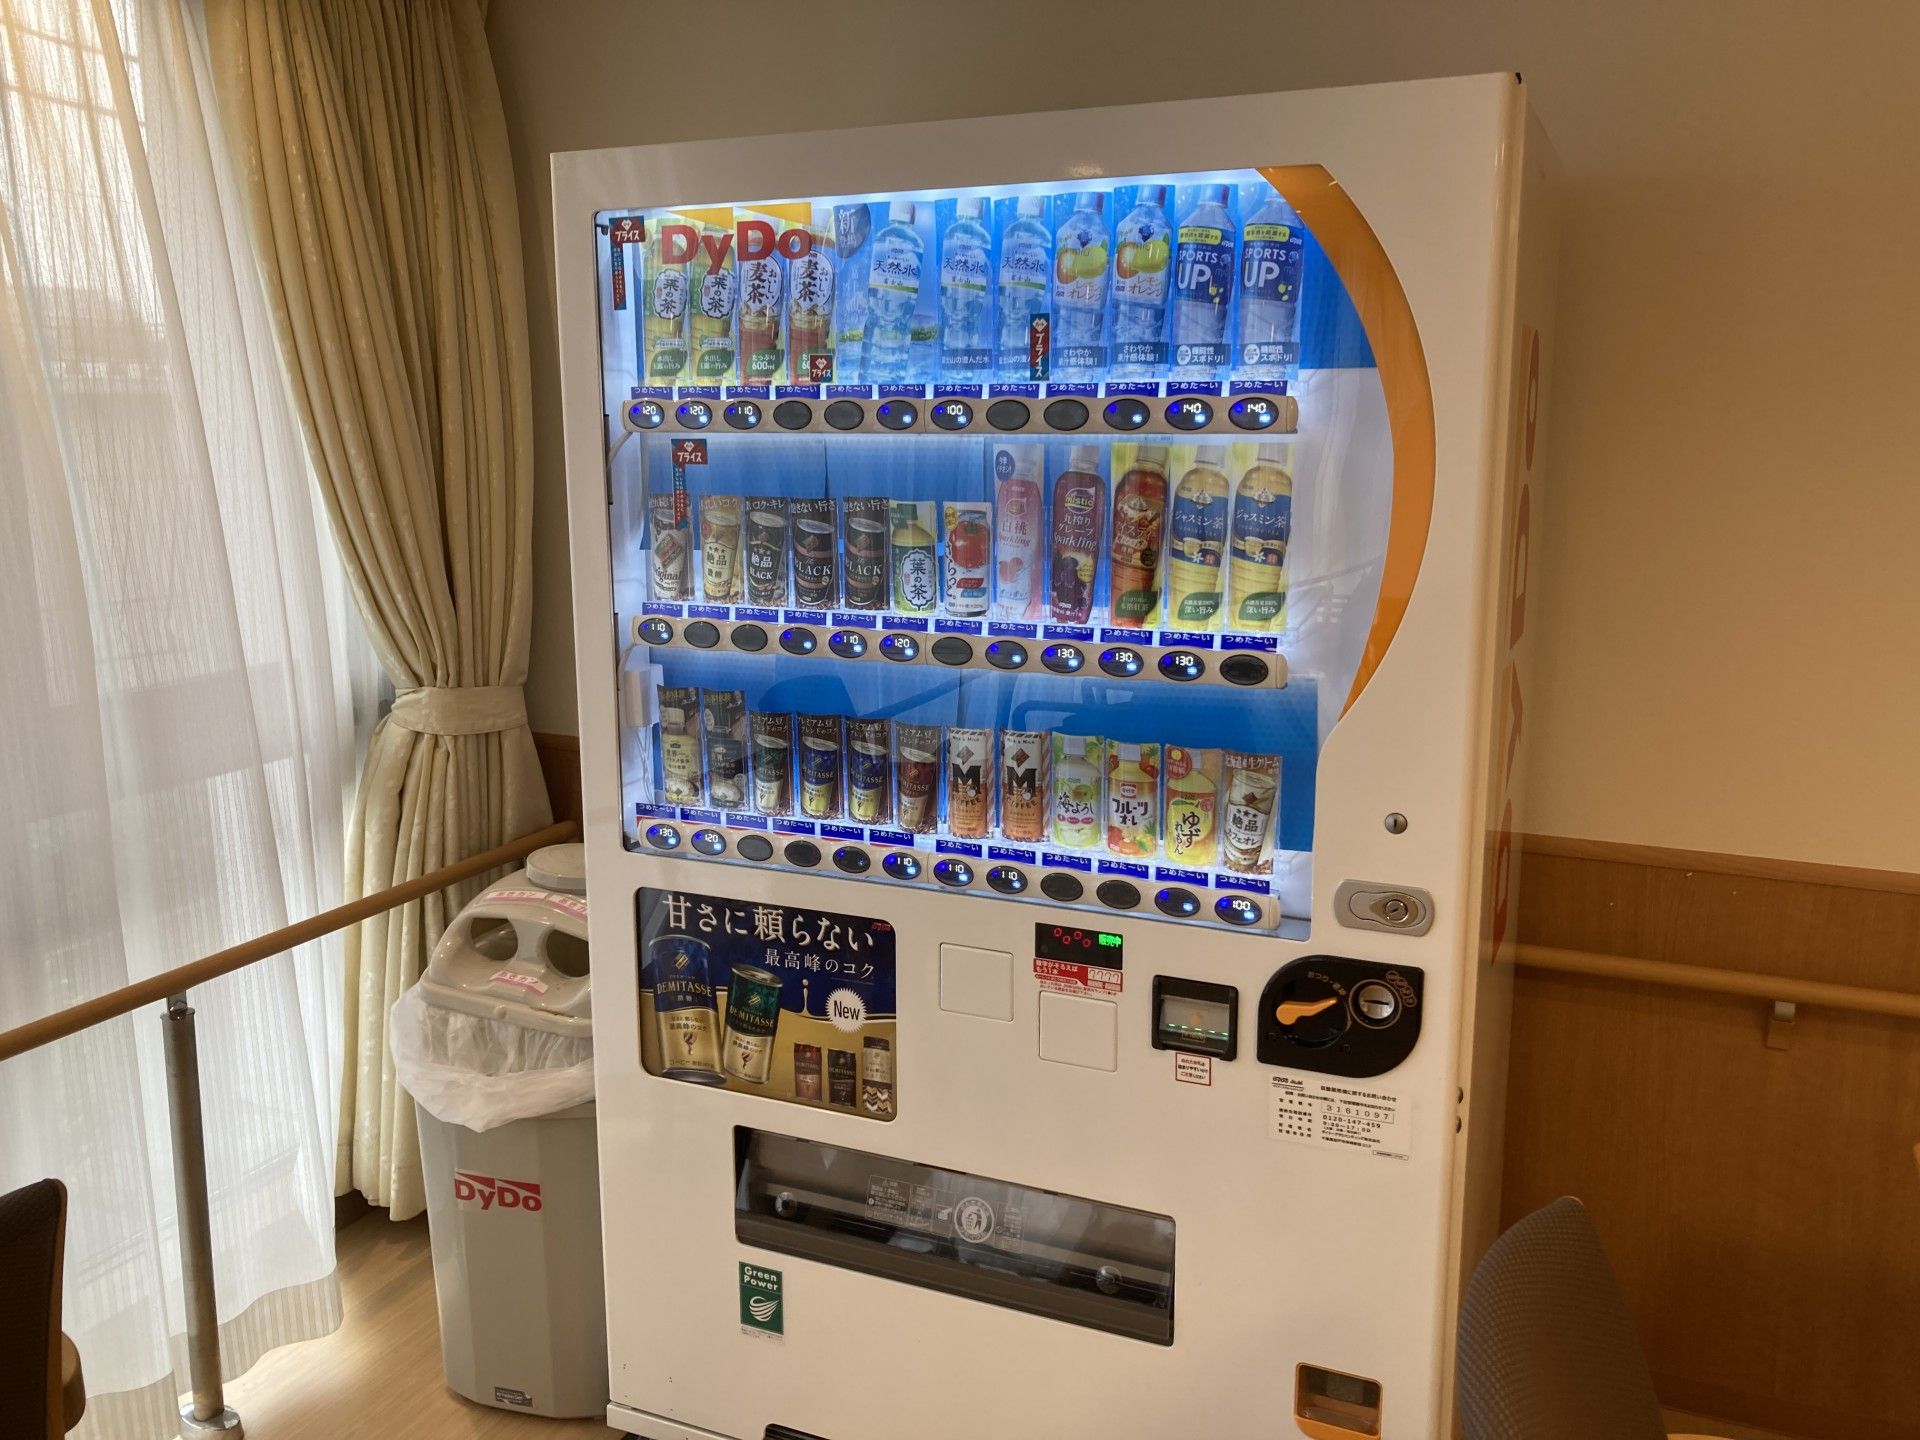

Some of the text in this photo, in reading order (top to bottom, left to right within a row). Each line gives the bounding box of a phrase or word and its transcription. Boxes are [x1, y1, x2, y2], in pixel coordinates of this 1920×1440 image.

[661, 220, 813, 276] DyDo
[1245, 247, 1286, 261] SPORTS
[1179, 249, 1218, 263] SPORTS
[944, 257, 985, 274] 天然水
[1002, 256, 1045, 273] 天然水
[798, 260, 820, 302] 麦茶
[1177, 263, 1212, 290] UP
[1243, 261, 1280, 287] UP
[747, 262, 769, 303] 麦茶
[1063, 348, 1092, 357] さわやか
[1123, 344, 1153, 352] さわやか
[643, 406, 656, 414] 120
[689, 406, 703, 415] 120
[738, 406, 752, 415] 110
[947, 405, 962, 415] 100
[1183, 403, 1201, 413] 140
[1247, 403, 1266, 413] 140
[1175, 510, 1223, 529] ジャスミン茶
[1236, 508, 1286, 528] ジャスミン茶
[751, 553, 772, 568] 絶品
[794, 559, 832, 576] BLACK
[750, 567, 773, 580] BLACK
[909, 558, 928, 601] 葉の茶
[1184, 606, 1214, 614] 深い旨み
[1246, 606, 1277, 614] 深い旨み
[652, 623, 665, 632] 110
[844, 636, 858, 644] 110
[895, 639, 909, 647] 120
[1115, 653, 1132, 661] 130
[1175, 657, 1193, 665] 130
[1111, 798, 1149, 816] フルーツ
[1182, 811, 1201, 848] ゆず
[1231, 814, 1258, 832] 絶品
[659, 828, 672, 836] 130
[705, 834, 718, 842] 120
[1174, 821, 1184, 855] れもん
[1228, 828, 1258, 846] カフェオレ
[897, 858, 912, 866] 110
[949, 863, 964, 872] 110
[1002, 871, 1017, 880] 110
[1232, 900, 1250, 910] 100
[662, 894, 874, 952] 甘さに頼らない
[764, 948, 875, 978] 最高峰のコク
[656, 979, 713, 997] DEMITASSE
[729, 1006, 775, 1027] DEMITASSE
[833, 1000, 861, 1020] New
[454, 1179, 543, 1212] DyDo
[744, 1265, 778, 1282] Green
[743, 1274, 780, 1291] Power
